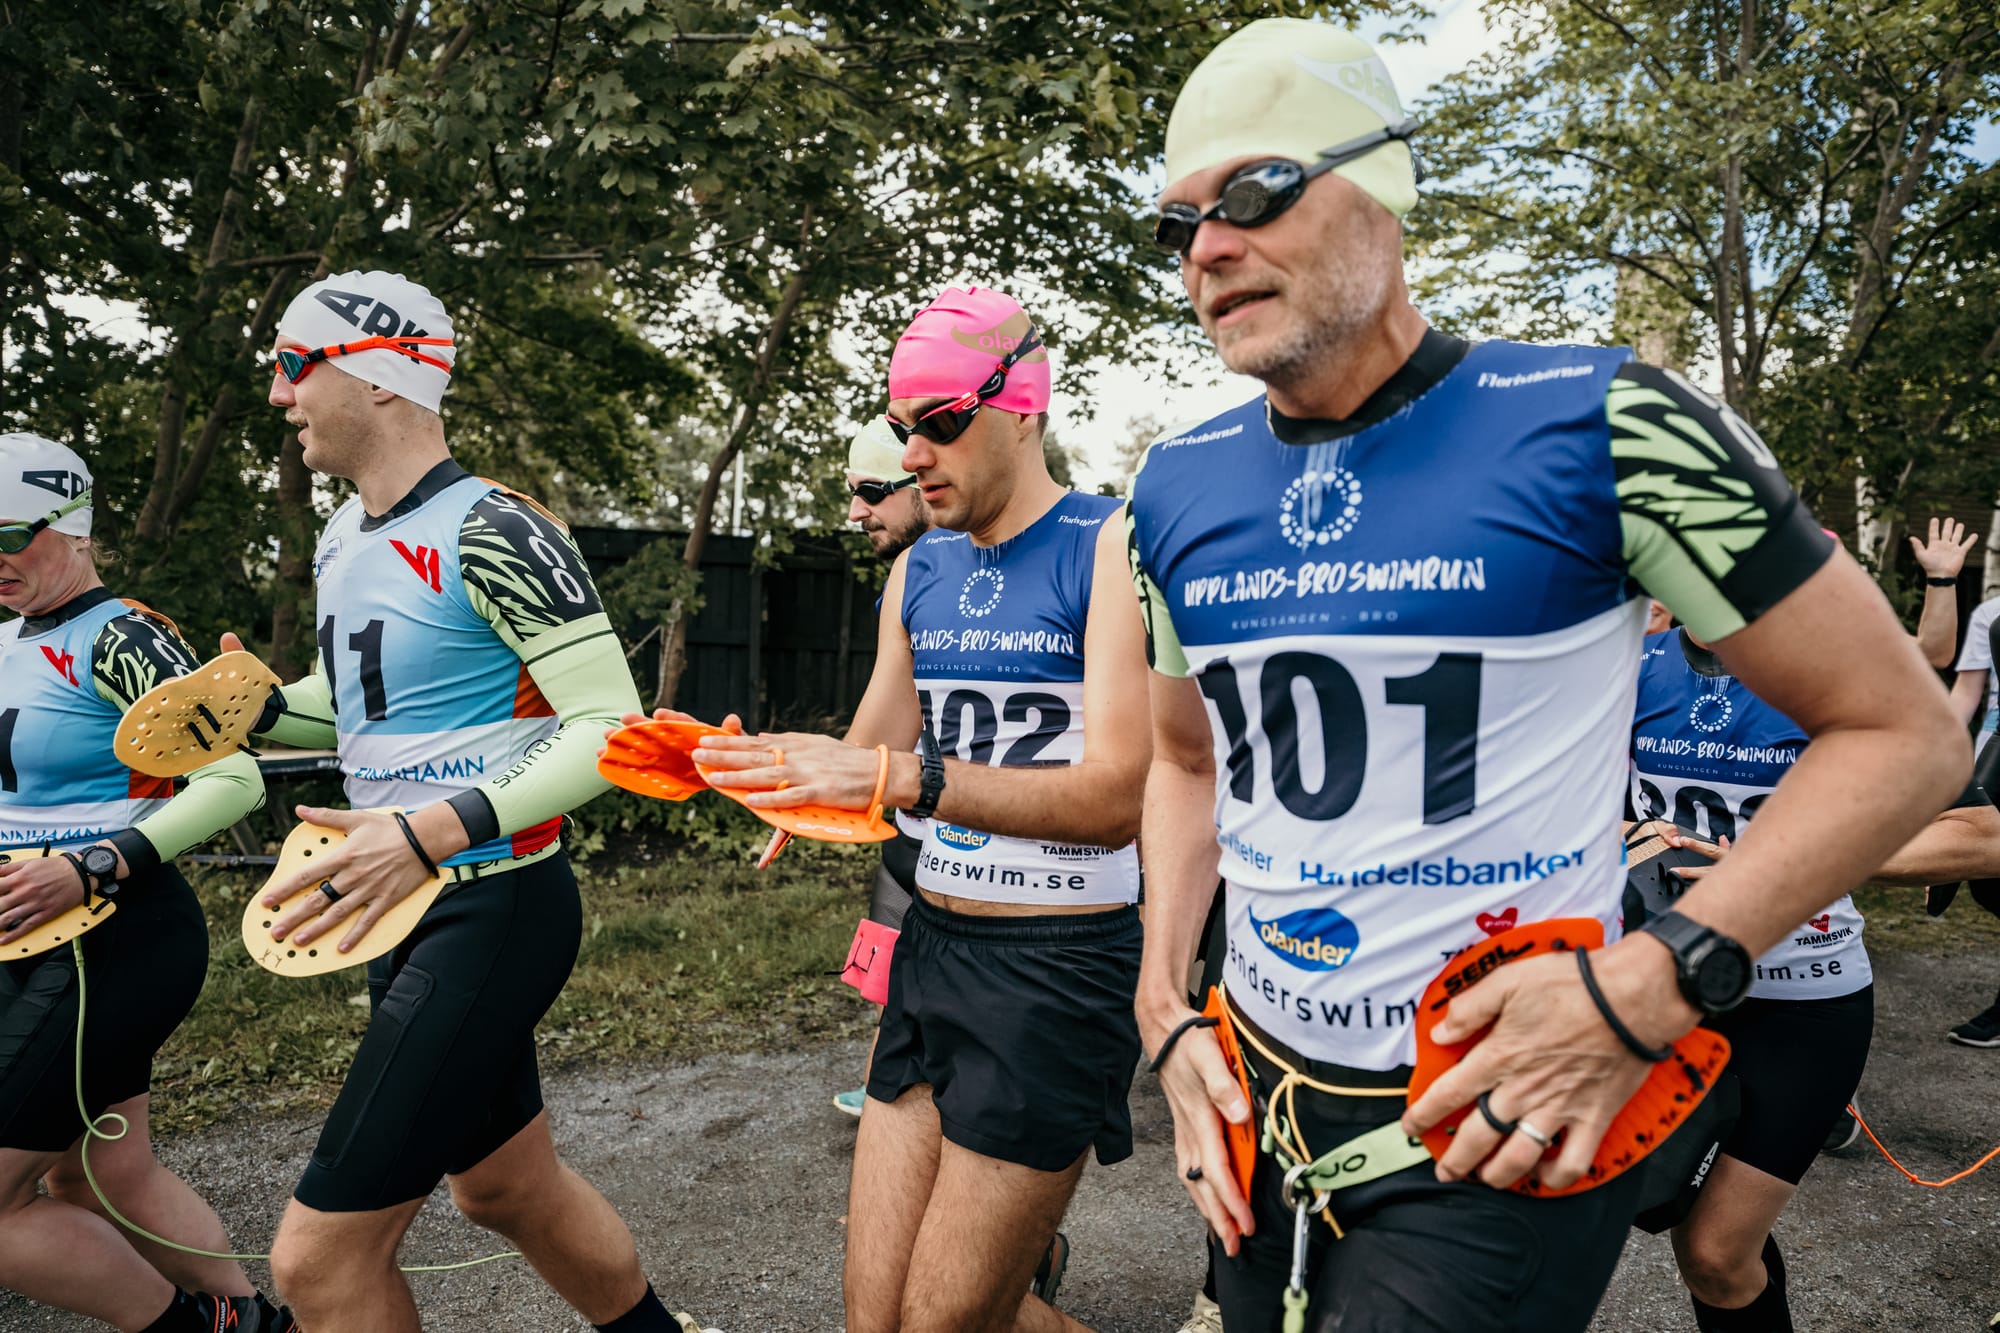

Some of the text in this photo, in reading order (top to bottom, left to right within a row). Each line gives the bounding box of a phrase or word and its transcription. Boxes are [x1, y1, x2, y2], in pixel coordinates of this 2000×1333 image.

[314, 288, 430, 365] ARK
[22, 470, 91, 501] AR
[1348, 555, 1486, 593] SWIMRUN
[1359, 610, 1399, 622] BRO
[991, 630, 1075, 655] SWIMRUN
[317, 614, 387, 721] 11
[998, 665, 1020, 673] BRO
[1197, 651, 1483, 825] 101
[1726, 744, 1797, 764] SWIMRUN
[1734, 770, 1755, 779] BRO
[796, 822, 853, 836] orca
[1795, 926, 1854, 946] TAMMSVIK
[1443, 944, 1516, 998] SEAL
[1756, 960, 1842, 980] im.se
[1690, 1141, 1719, 1188] ARK
